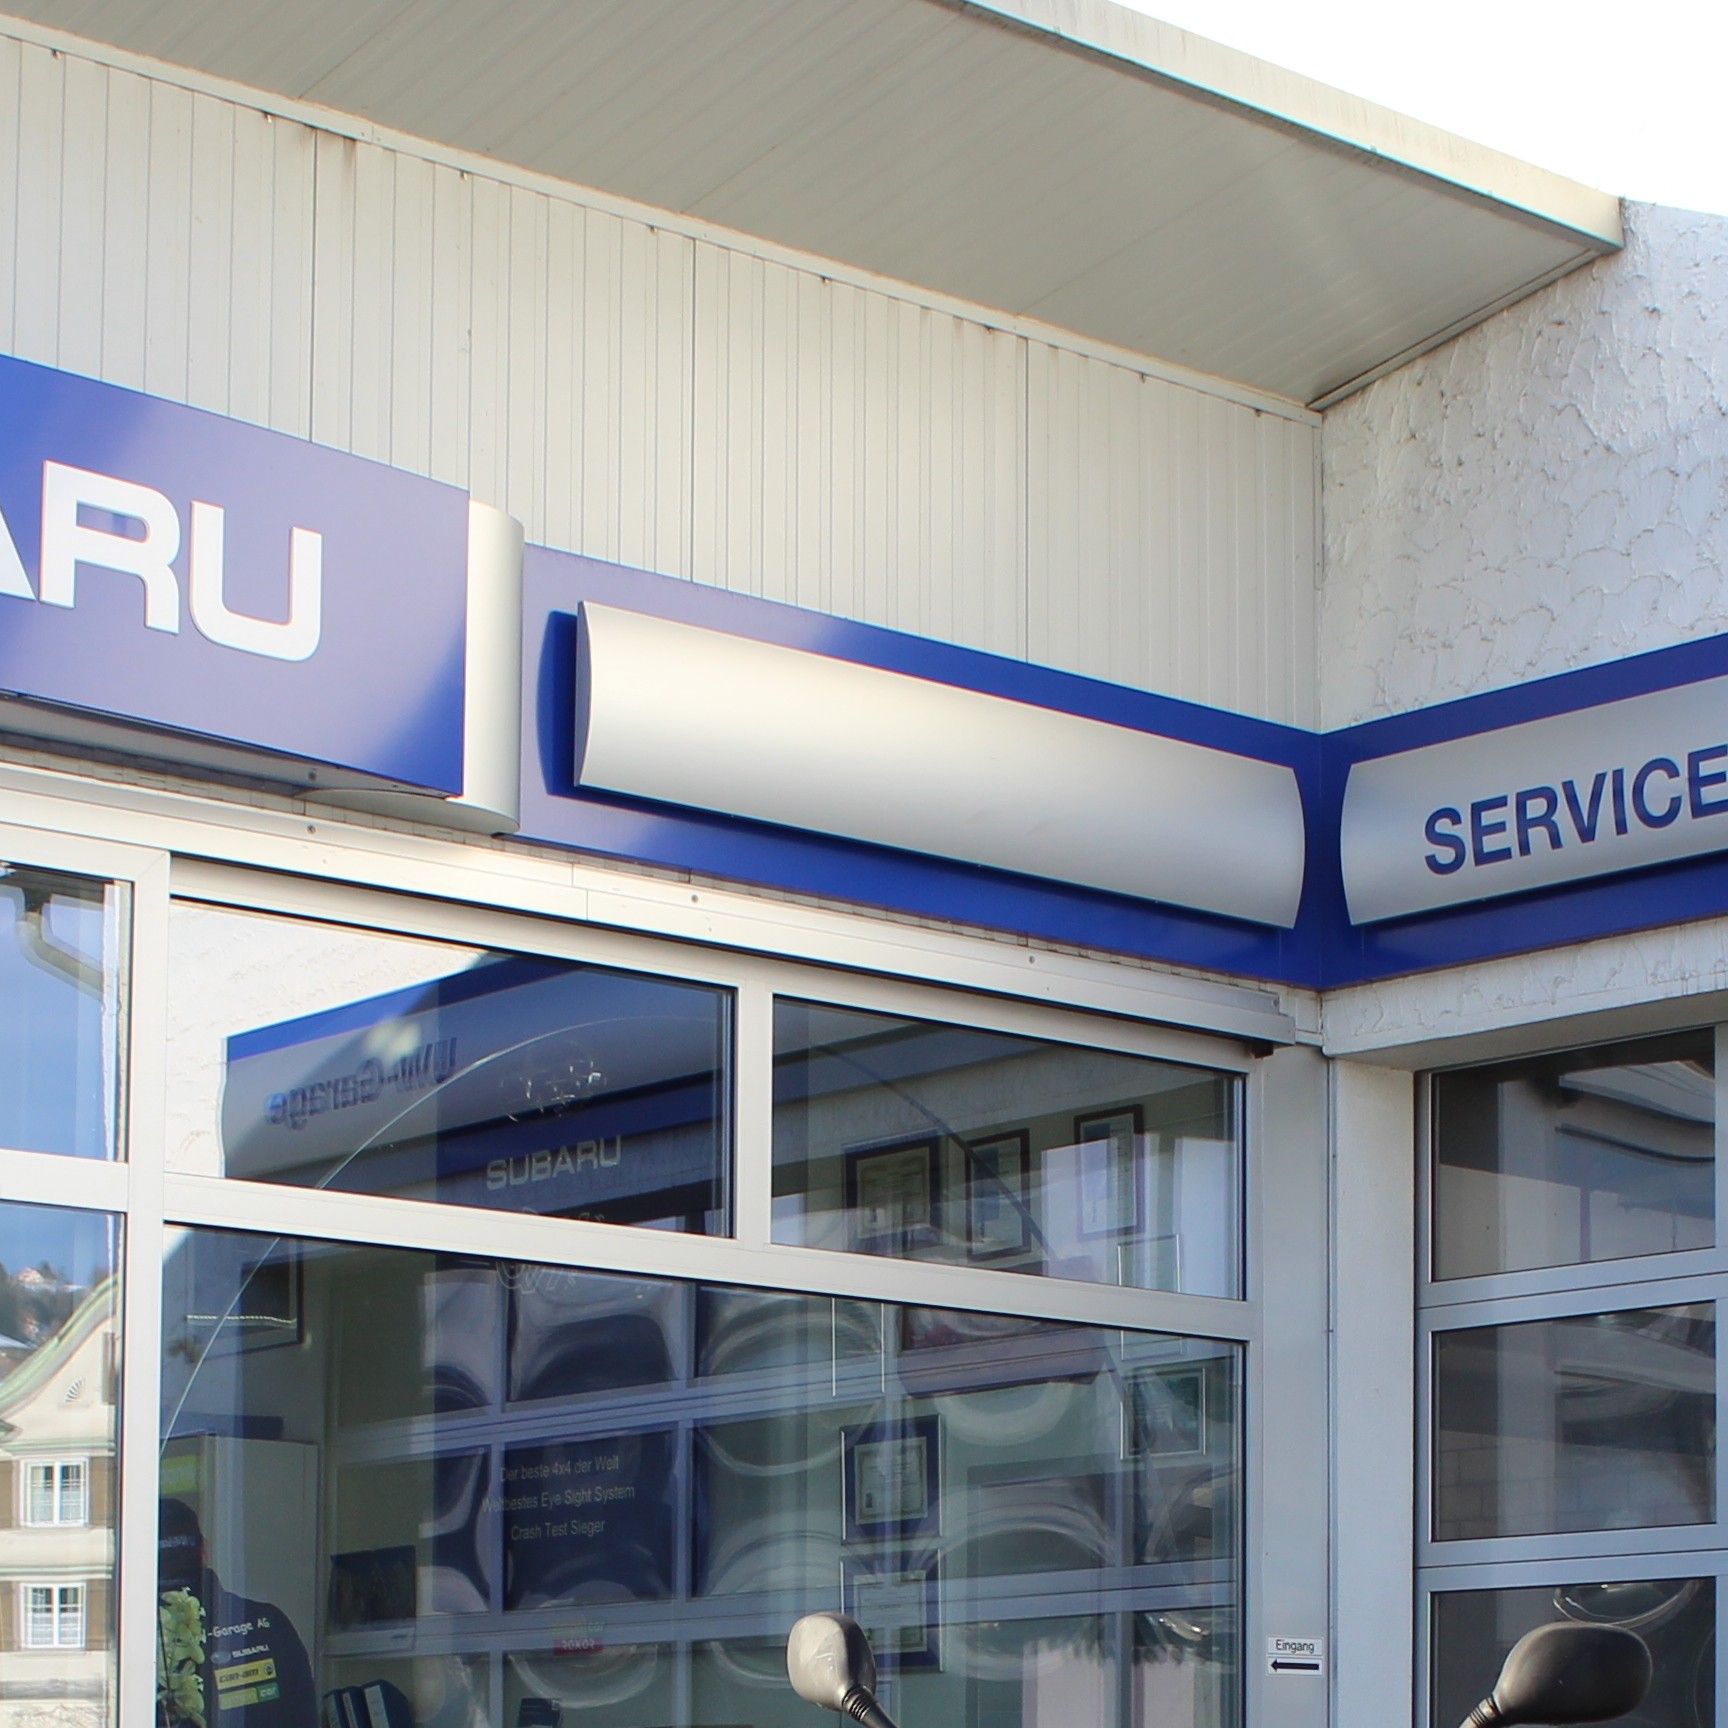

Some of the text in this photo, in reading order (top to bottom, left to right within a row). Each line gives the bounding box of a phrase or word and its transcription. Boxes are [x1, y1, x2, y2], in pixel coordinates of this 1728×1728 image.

[486, 1134, 622, 1191] SUBARU
[594, 1485, 635, 1504] System
[511, 1523, 542, 1541] Crash
[545, 1521, 567, 1537] Test
[1276, 1639, 1314, 1654] Eingang
